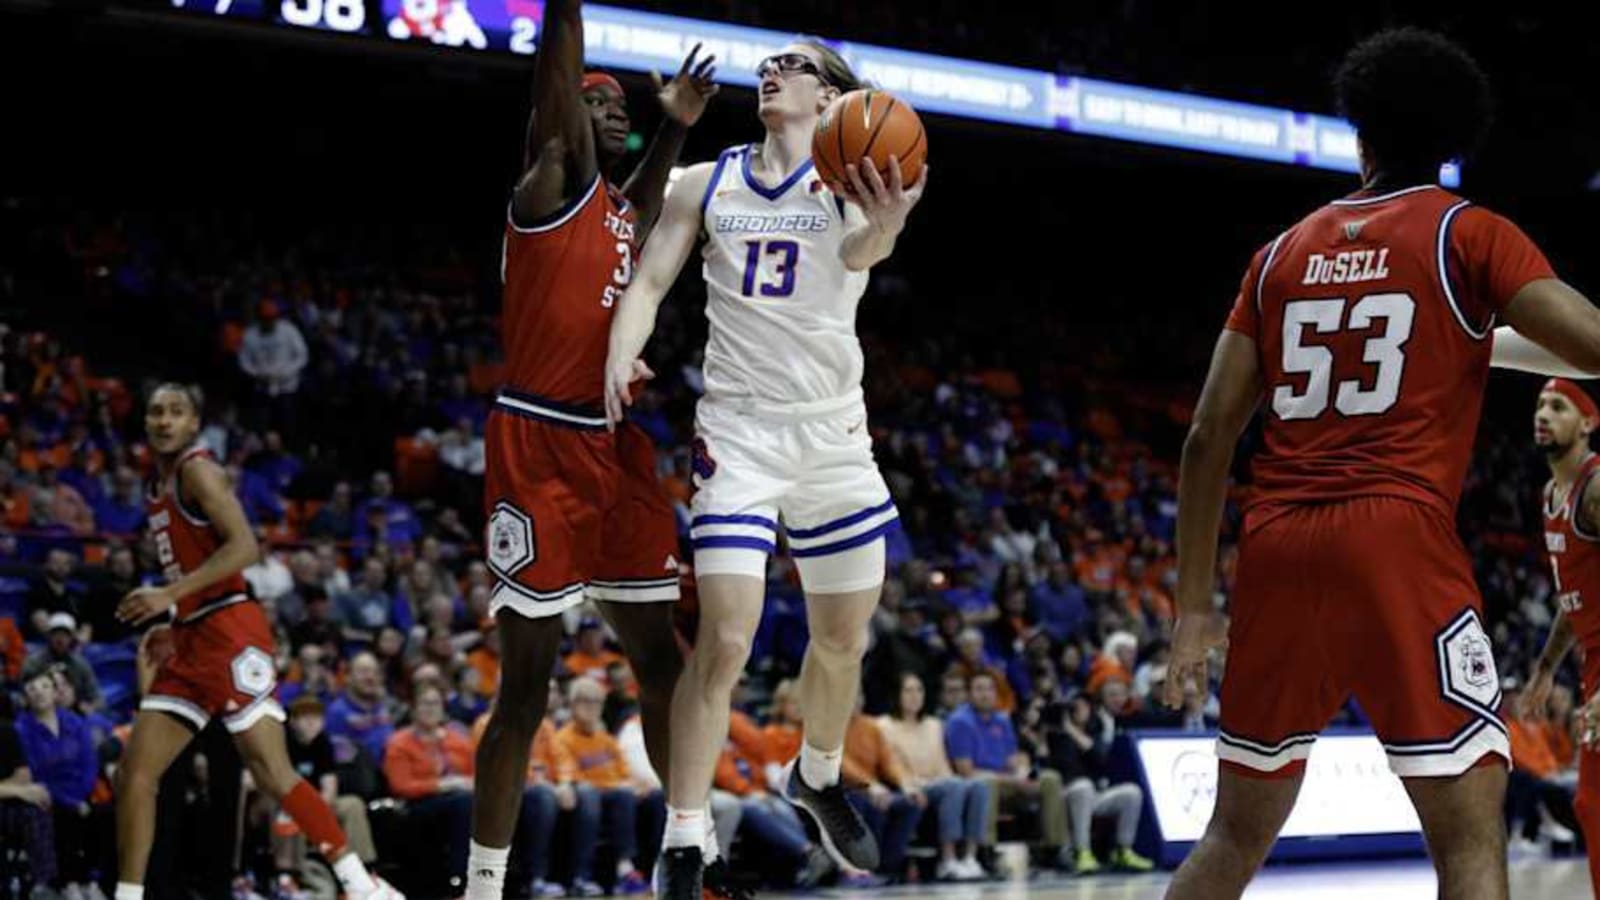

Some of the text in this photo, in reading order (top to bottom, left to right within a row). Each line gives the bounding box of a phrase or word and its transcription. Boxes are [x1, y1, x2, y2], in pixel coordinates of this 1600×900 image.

[509, 16, 537, 54] 2
[716, 214, 829, 233] BRONCOS
[742, 240, 800, 297] 13
[1271, 292, 1417, 421] 53
